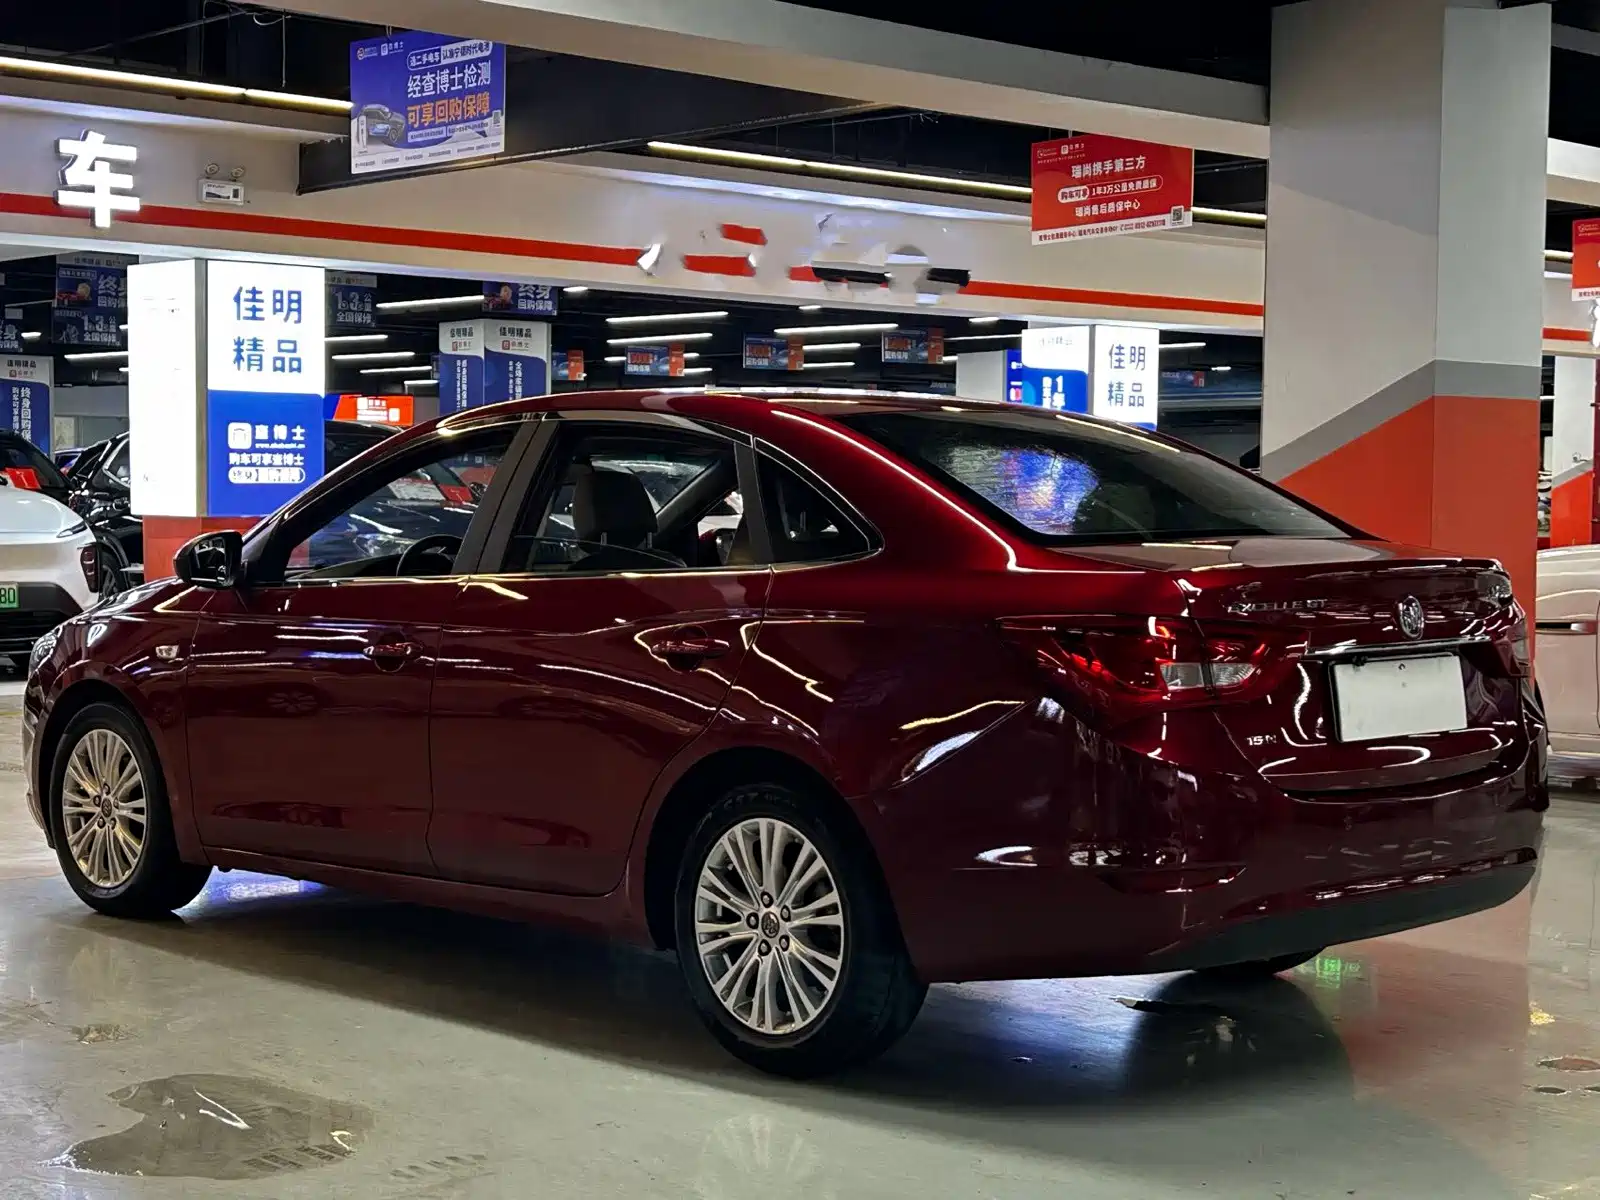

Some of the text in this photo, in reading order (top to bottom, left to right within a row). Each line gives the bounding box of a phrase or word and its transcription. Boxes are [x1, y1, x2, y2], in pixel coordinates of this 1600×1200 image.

[407, 60, 491, 98] 经查博士检测
[407, 92, 490, 128] 可享回购保障
[54, 129, 140, 228] 车
[233, 285, 303, 324] 佳明
[499, 327, 532, 338] 佳明精品
[233, 336, 302, 374] 精品
[1108, 344, 1146, 370] 佳明
[1107, 381, 1145, 407] 精品
